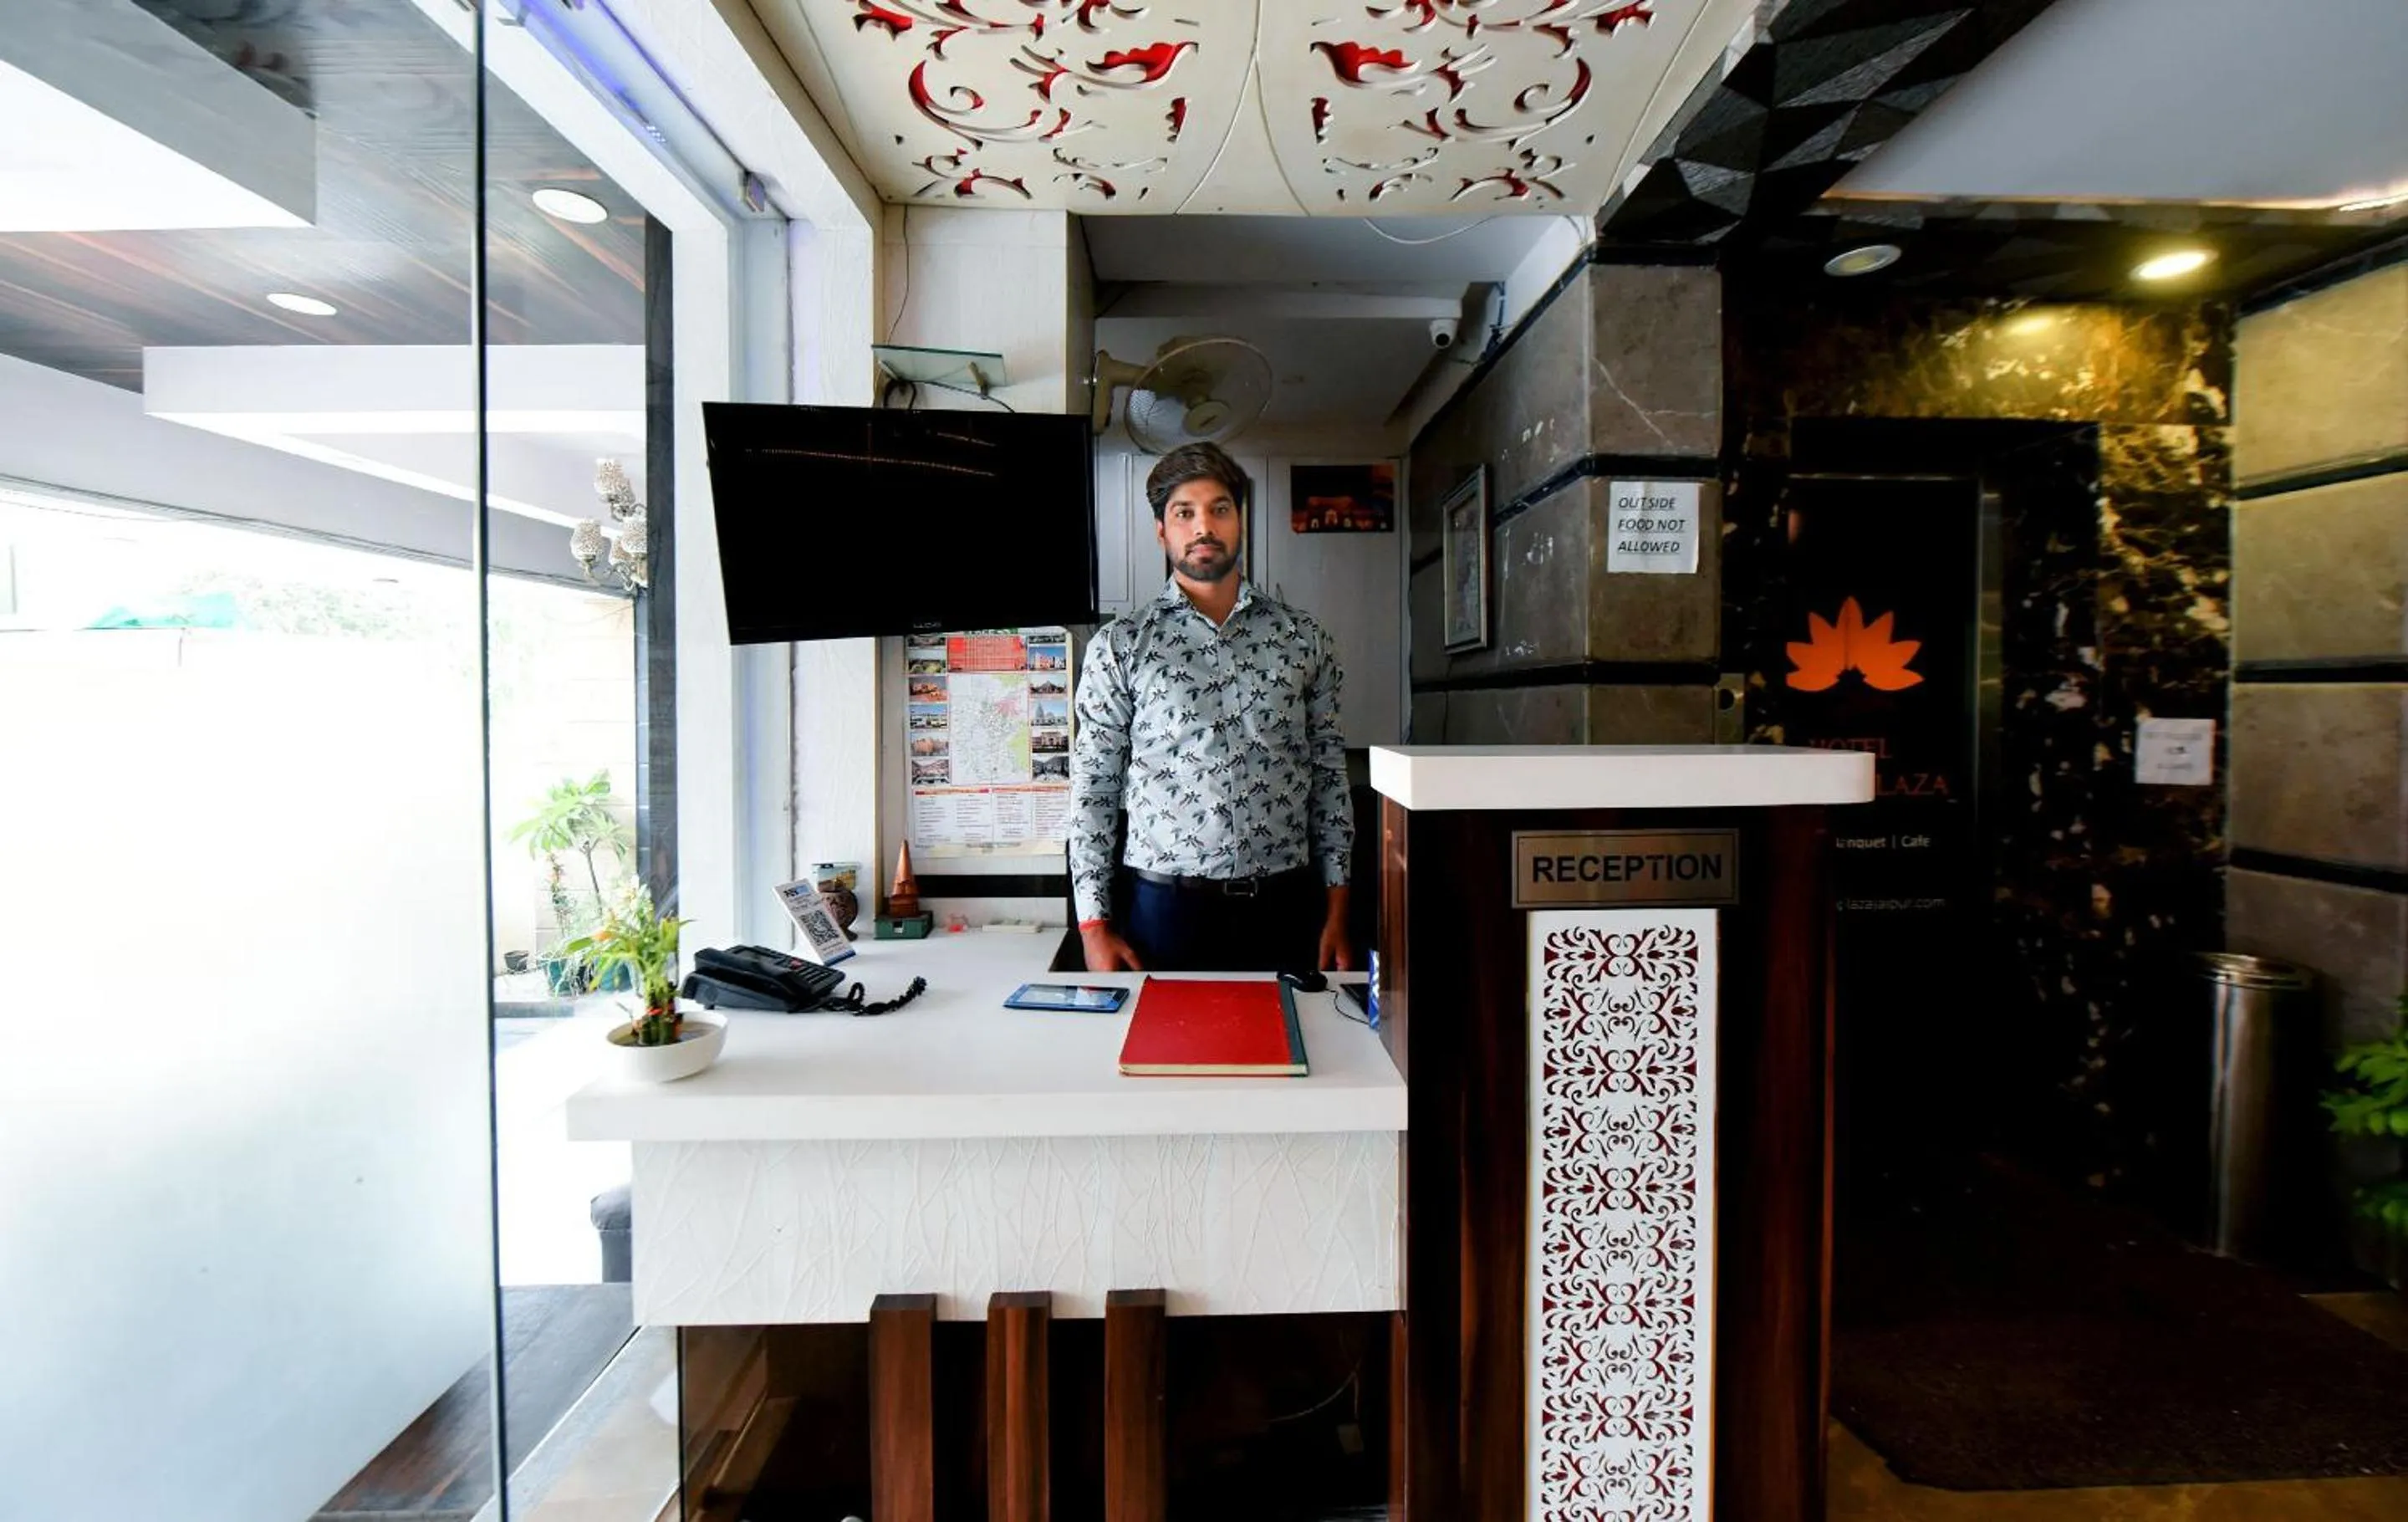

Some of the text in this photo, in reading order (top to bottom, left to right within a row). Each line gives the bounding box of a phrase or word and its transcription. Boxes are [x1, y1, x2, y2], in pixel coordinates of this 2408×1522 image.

[1618, 497, 1676, 508] OUTSIDE
[1618, 518, 1686, 530] FOOD NOT
[1617, 540, 1681, 552] ALLOWED
[1875, 773, 1949, 795] LAZA
[1836, 837, 1886, 849] anquet
[1533, 854, 1722, 883] RECEPTION
